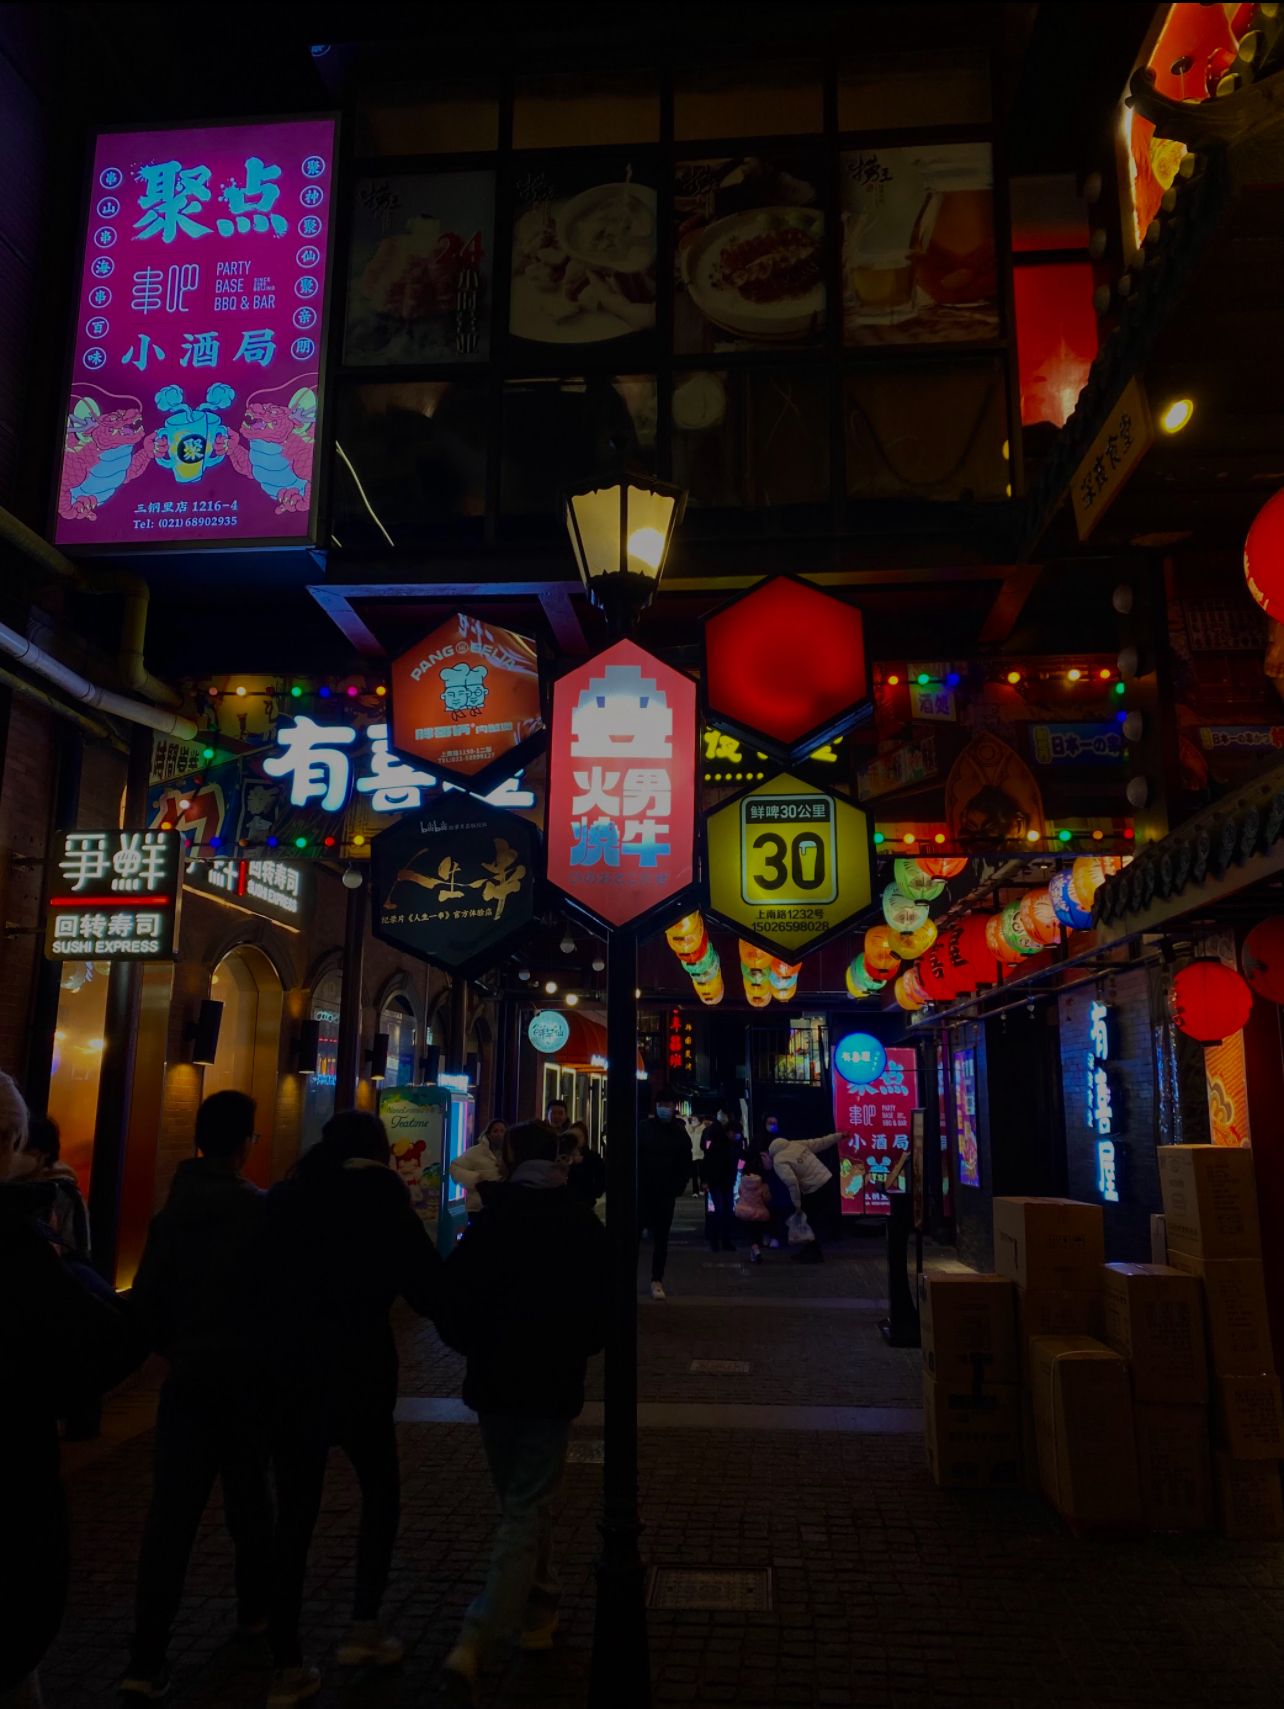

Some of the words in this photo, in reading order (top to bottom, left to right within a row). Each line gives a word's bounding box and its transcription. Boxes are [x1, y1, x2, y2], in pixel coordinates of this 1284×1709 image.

[131, 157, 289, 243] 聚点
[437, 231, 484, 263] 24
[216, 260, 252, 276] PARTY
[131, 264, 199, 314] 串吧
[215, 278, 244, 293] BASE
[214, 296, 237, 311] BBQ
[241, 295, 250, 310] &
[253, 294, 275, 310] BAR
[122, 328, 277, 371] 小酒局
[183, 437, 206, 461] 聚
[192, 500, 238, 512] 1216-4
[133, 519, 154, 529] Tel:
[410, 645, 454, 681] PANG
[572, 766, 672, 817] 火男
[750, 804, 826, 820] 鲜啤30公里
[421, 820, 448, 833] bilibili
[753, 832, 825, 890] 30
[756, 910, 824, 920] 上南路1232号
[54, 914, 161, 938] 回转寿司
[752, 922, 829, 932] 15026598028
[52, 940, 92, 954] SUSHI
[95, 939, 159, 954] EXPRESS
[849, 1104, 876, 1126] 串吧
[882, 1104, 896, 1112] PARTY
[391, 1115, 429, 1128] Teatime
[848, 1133, 909, 1151] 小酒局
